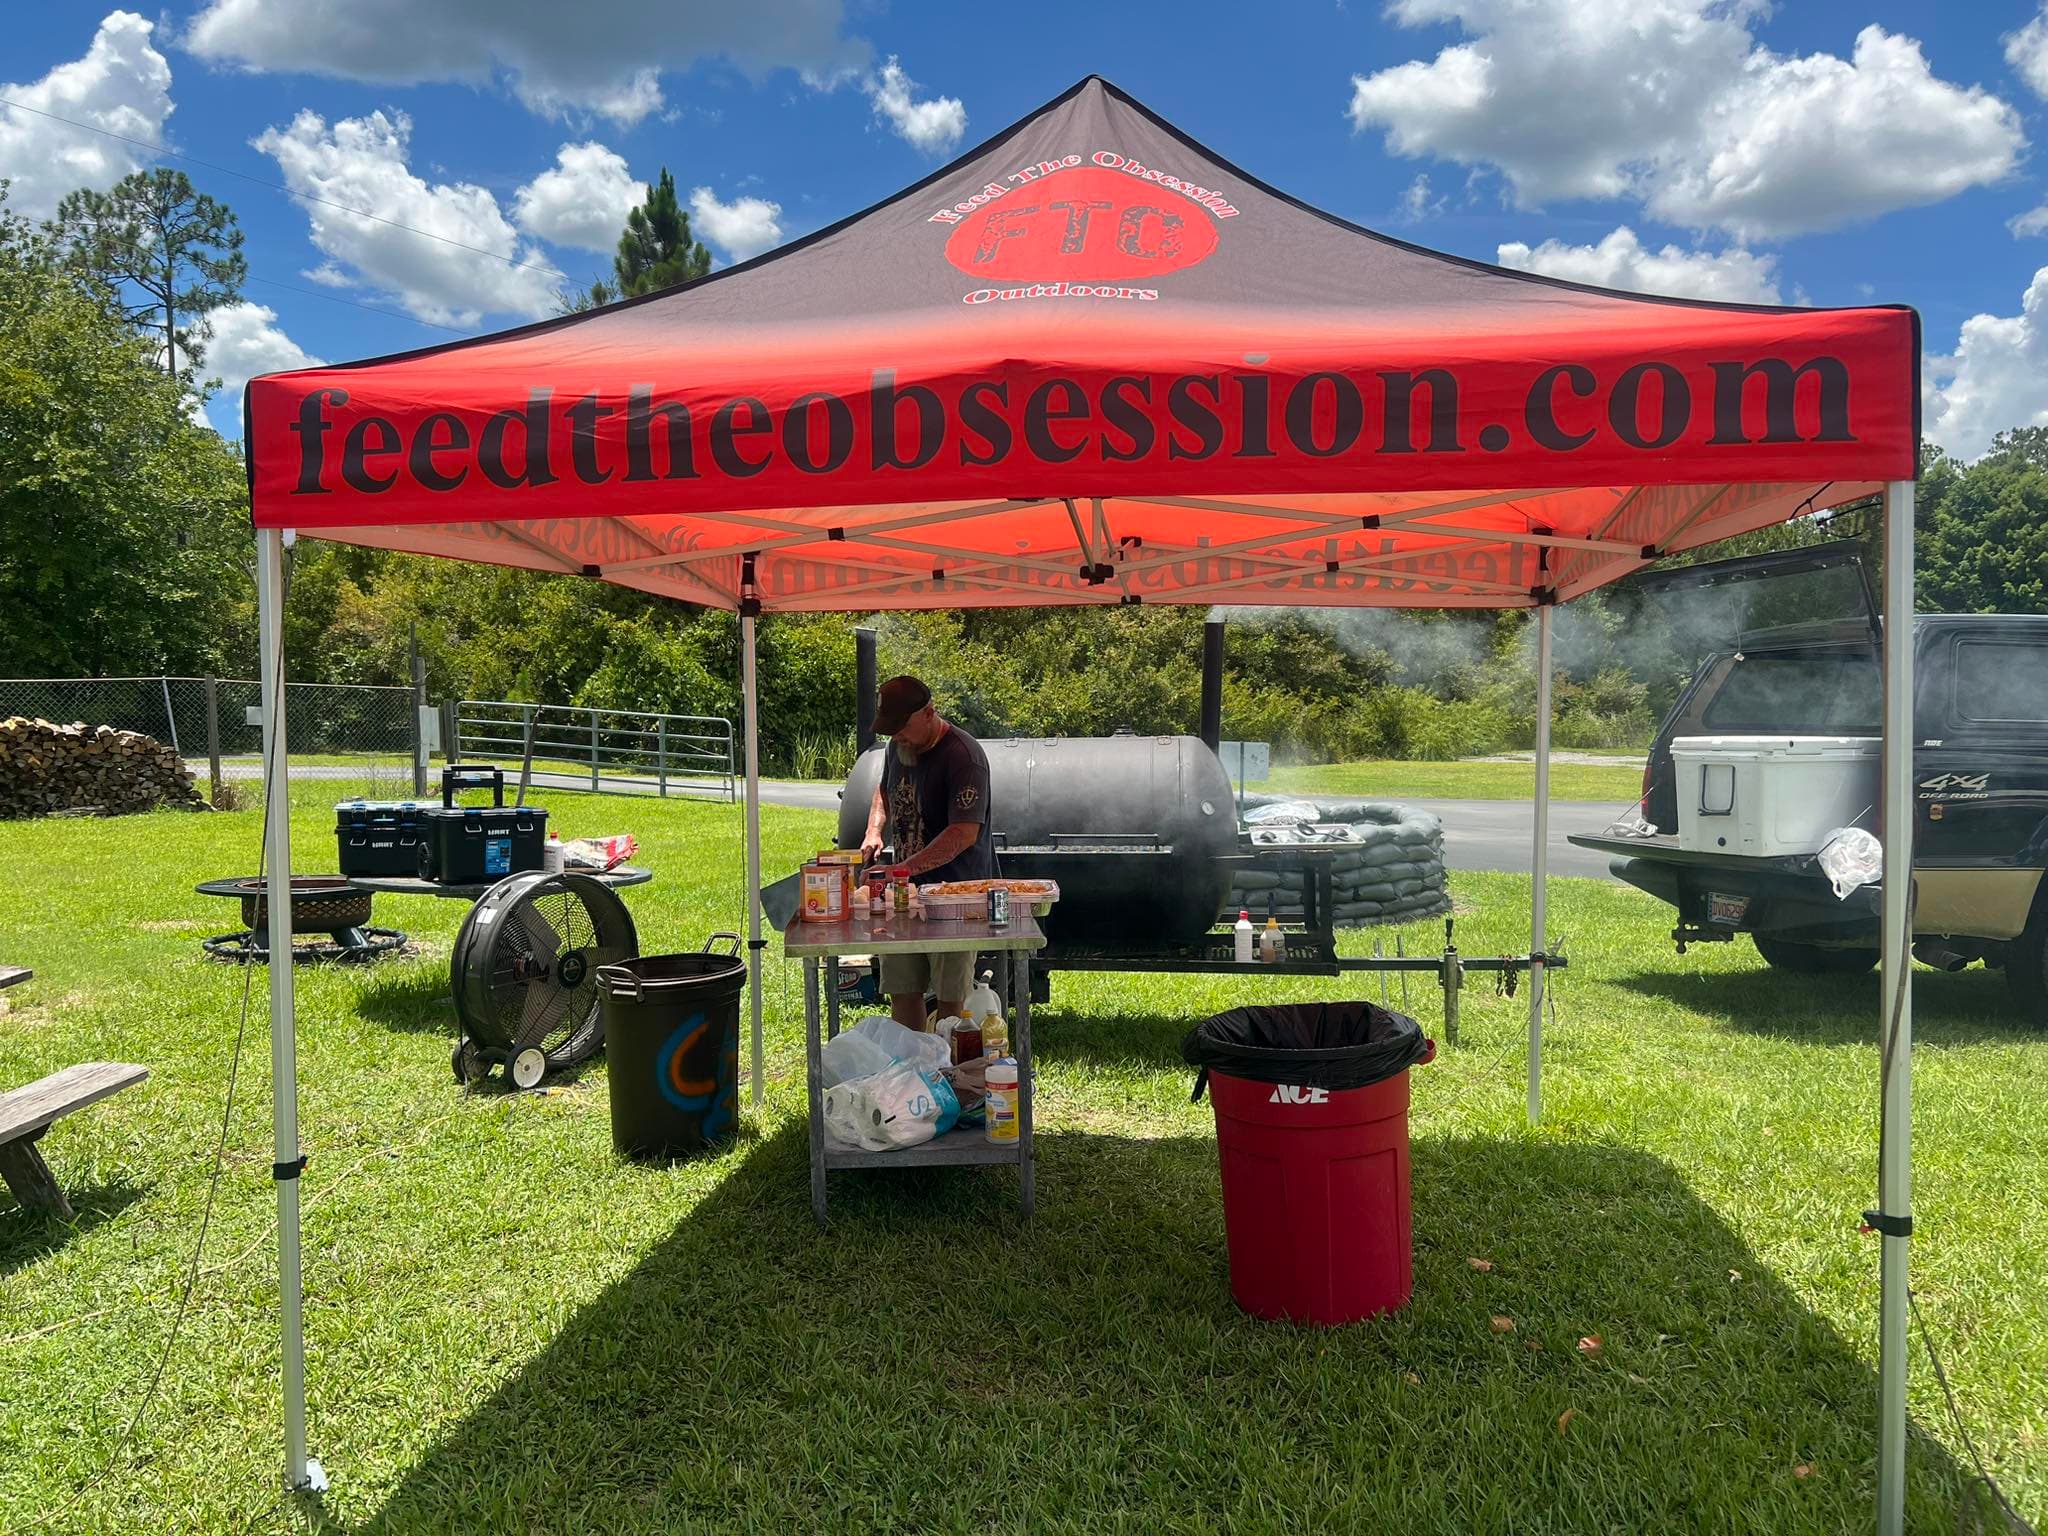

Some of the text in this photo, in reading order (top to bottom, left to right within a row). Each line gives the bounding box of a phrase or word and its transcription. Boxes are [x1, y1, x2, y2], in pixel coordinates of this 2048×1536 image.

[928, 151, 1240, 226] Feed The Obsession
[962, 282, 1158, 305] Outdoors
[288, 351, 1859, 495] feedtheobsession.com
[1269, 1084, 1329, 1104] ACE
